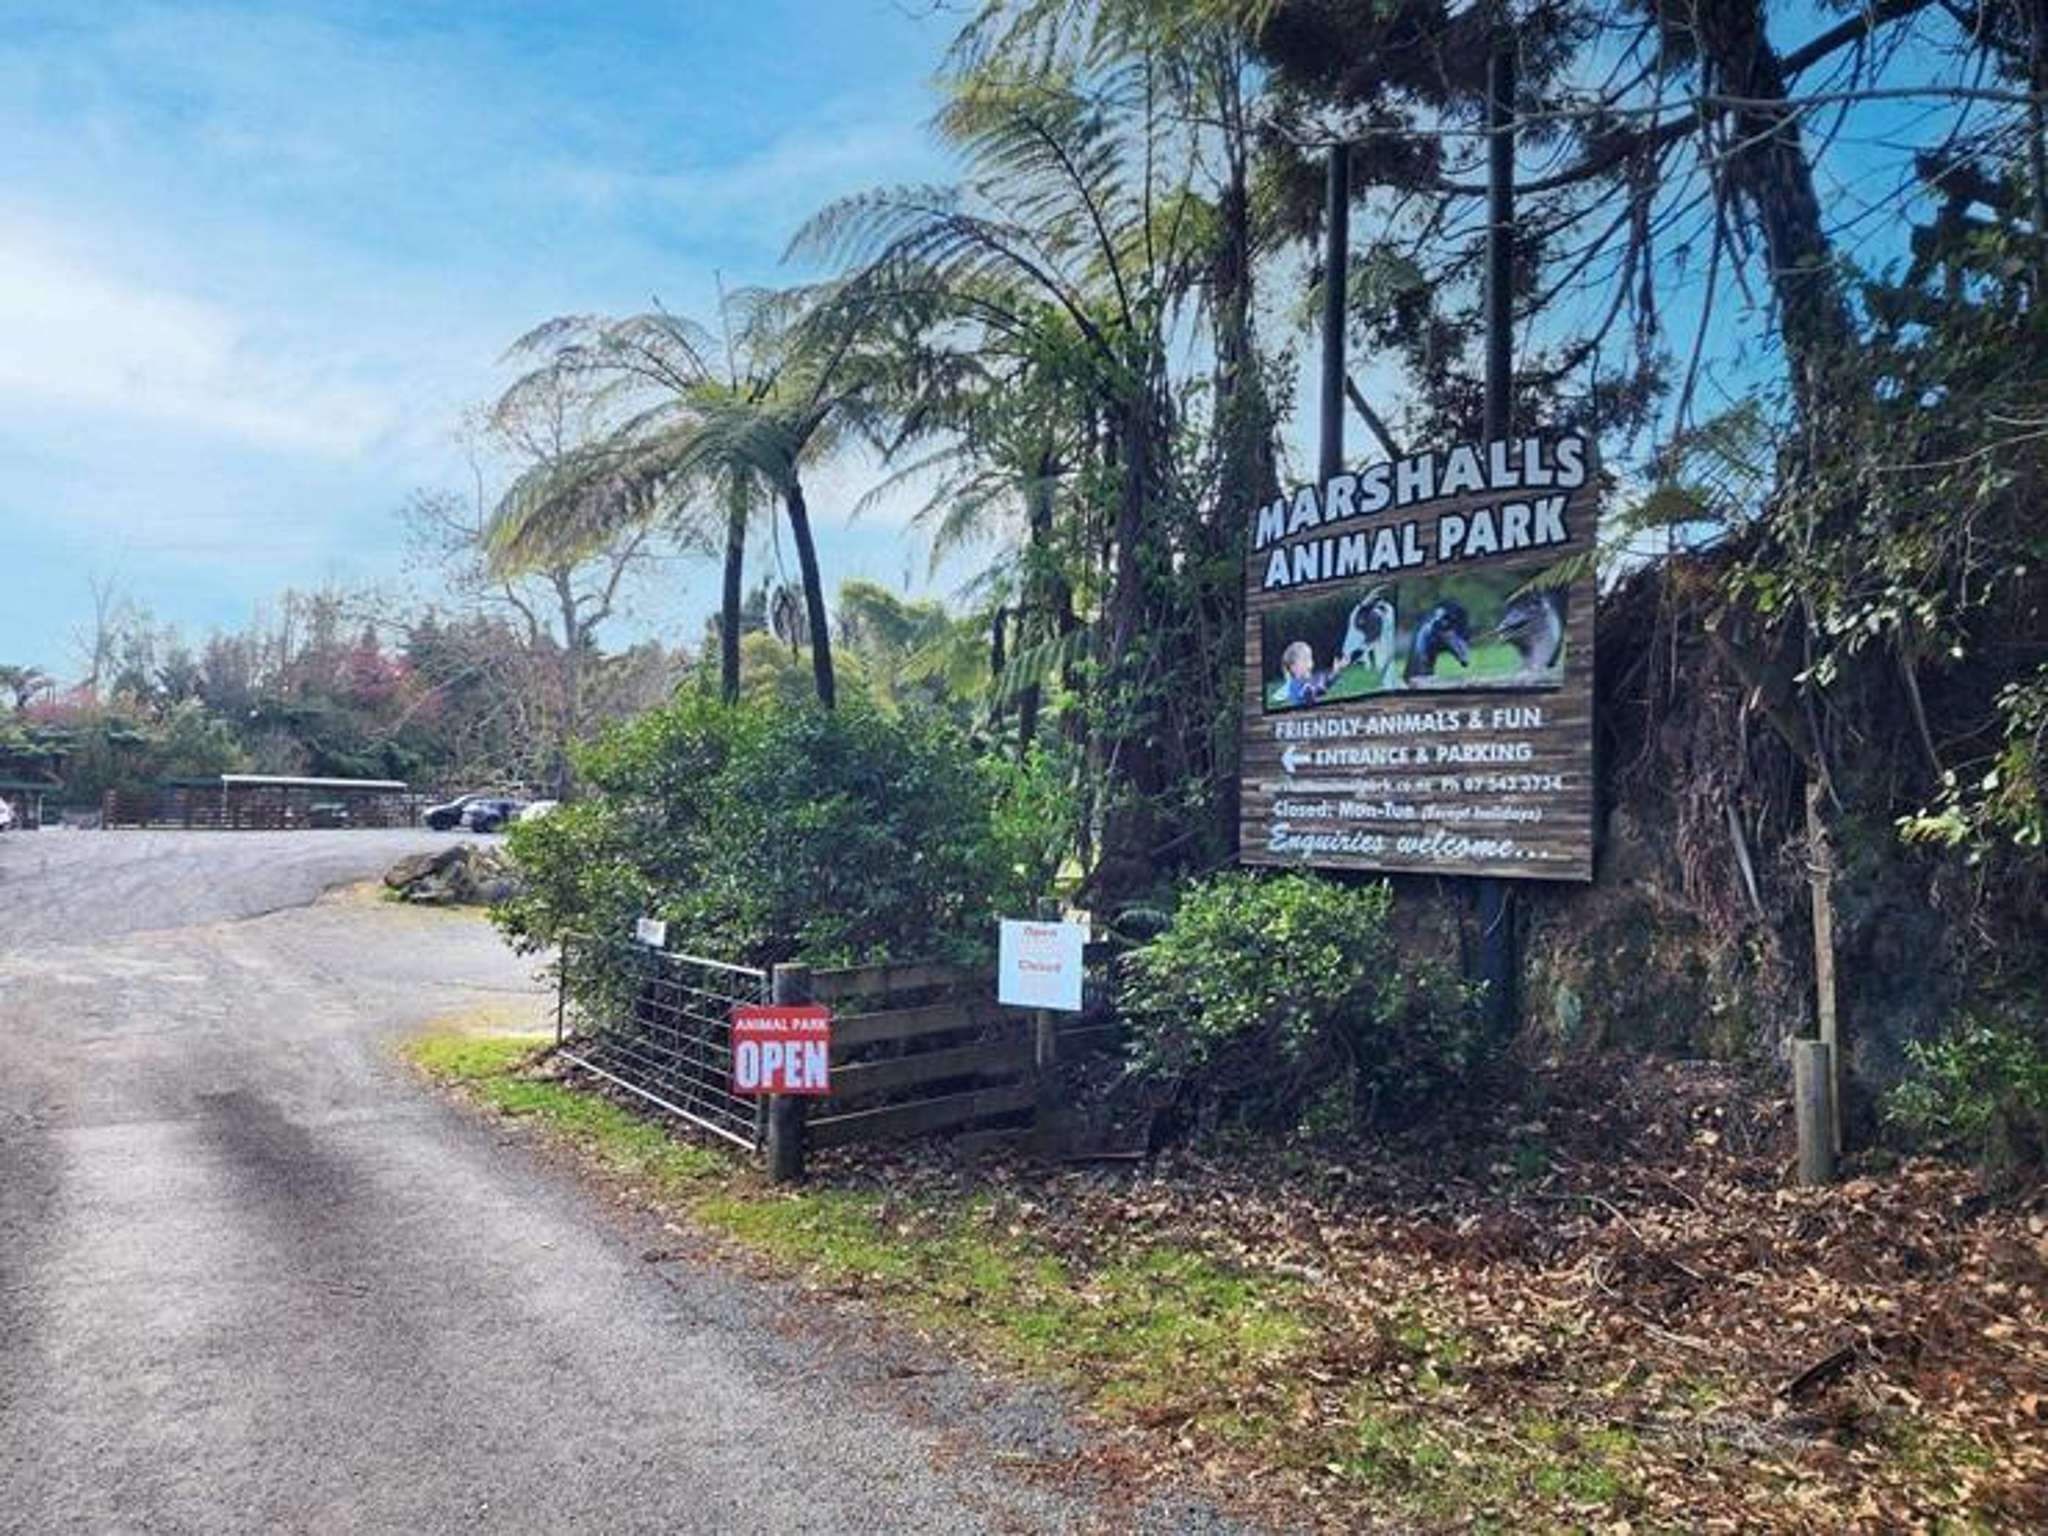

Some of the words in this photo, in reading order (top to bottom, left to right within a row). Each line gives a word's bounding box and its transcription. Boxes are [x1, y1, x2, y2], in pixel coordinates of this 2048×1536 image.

[1254, 437, 1587, 550] MARSHALLS
[1263, 523, 1425, 590] ANIMAL
[1435, 496, 1569, 562] PARK
[1367, 711, 1459, 734] ANIMALS
[1468, 712, 1483, 728] &
[1493, 707, 1543, 728] FUN
[1315, 747, 1409, 765] ENTRANCE
[1416, 747, 1429, 763] &
[1436, 742, 1533, 762] PARKING
[1273, 799, 1332, 817] Closed:
[735, 1017, 788, 1031] ANIMAL
[792, 1018, 828, 1031] PARK
[736, 1039, 829, 1089] OPEN
